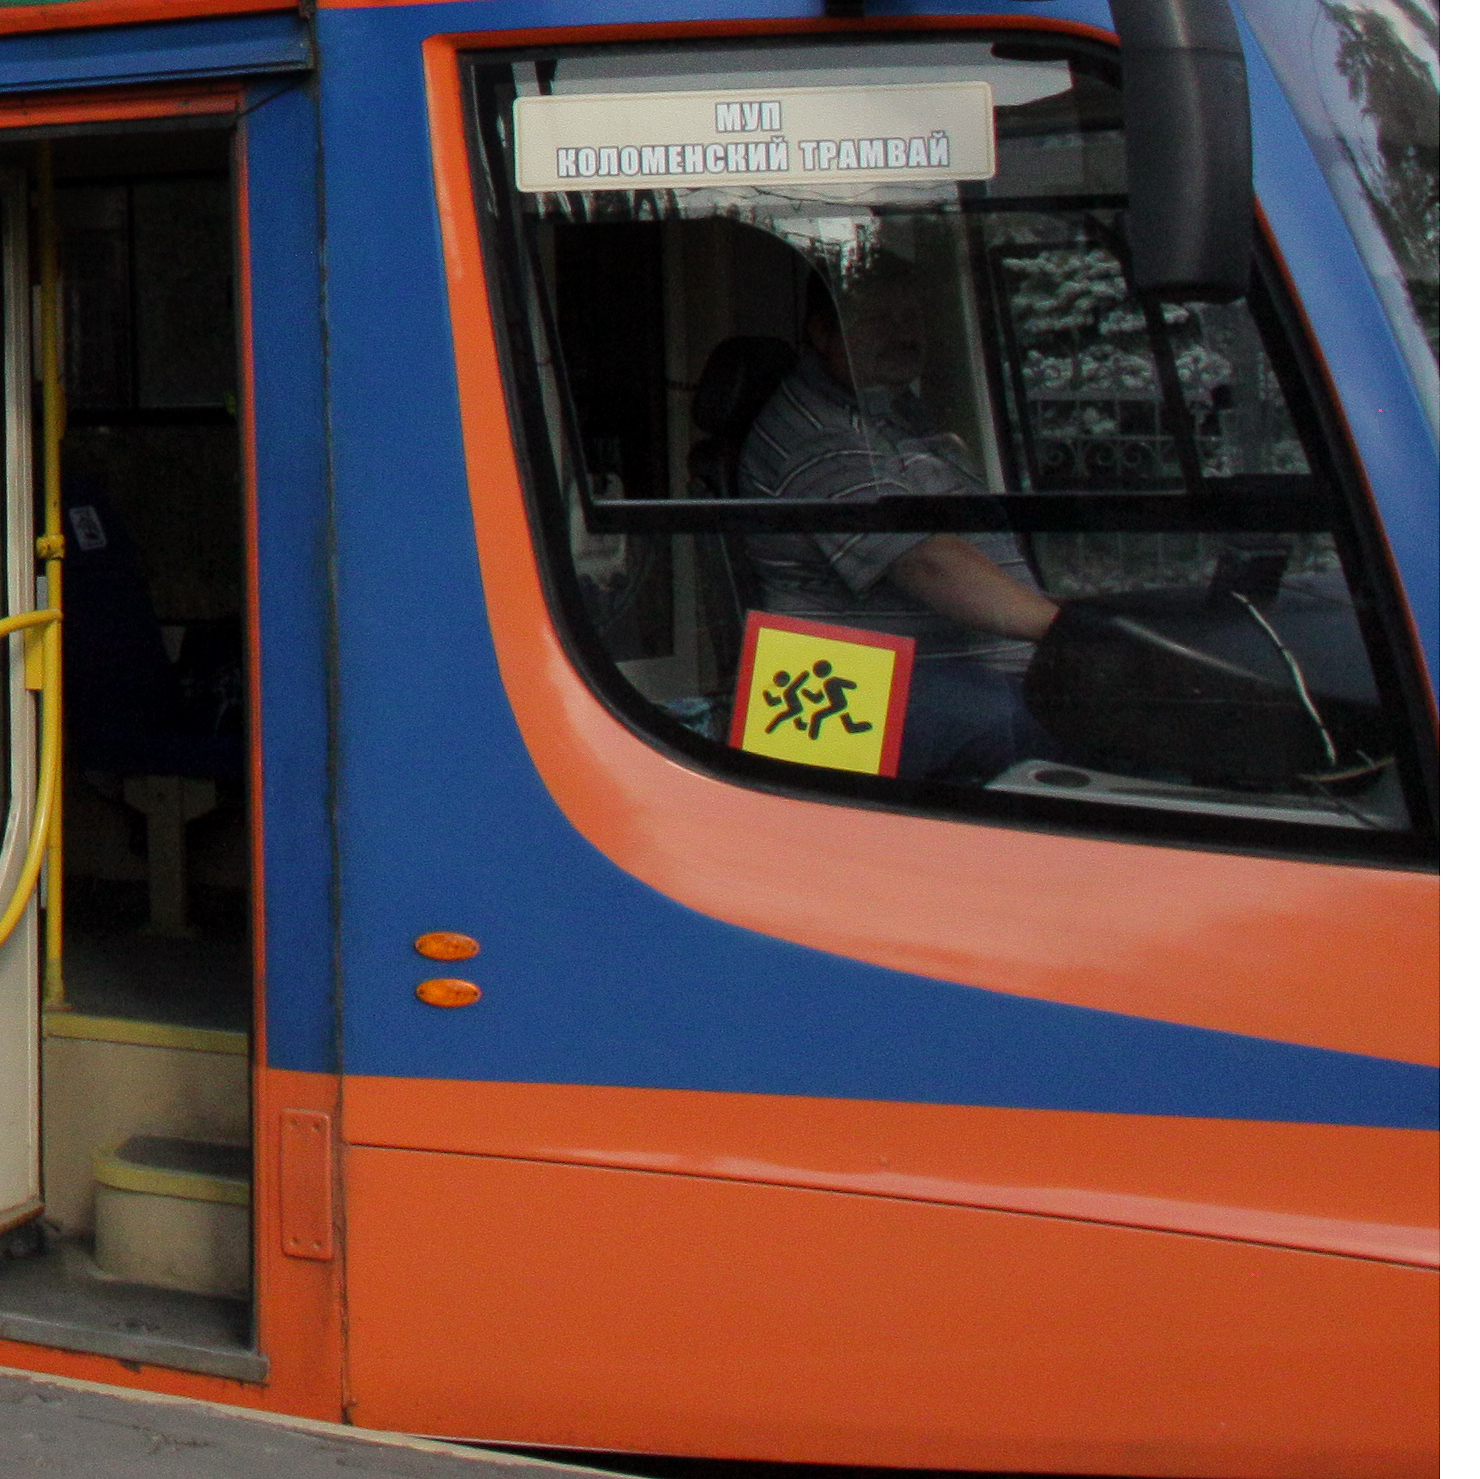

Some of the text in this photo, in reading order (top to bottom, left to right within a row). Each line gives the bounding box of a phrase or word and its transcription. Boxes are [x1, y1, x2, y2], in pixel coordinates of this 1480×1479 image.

[715, 100, 782, 133] МУП
[557, 130, 951, 177] КОЛОМЕНСКИЙ ТРАМВАЙ
